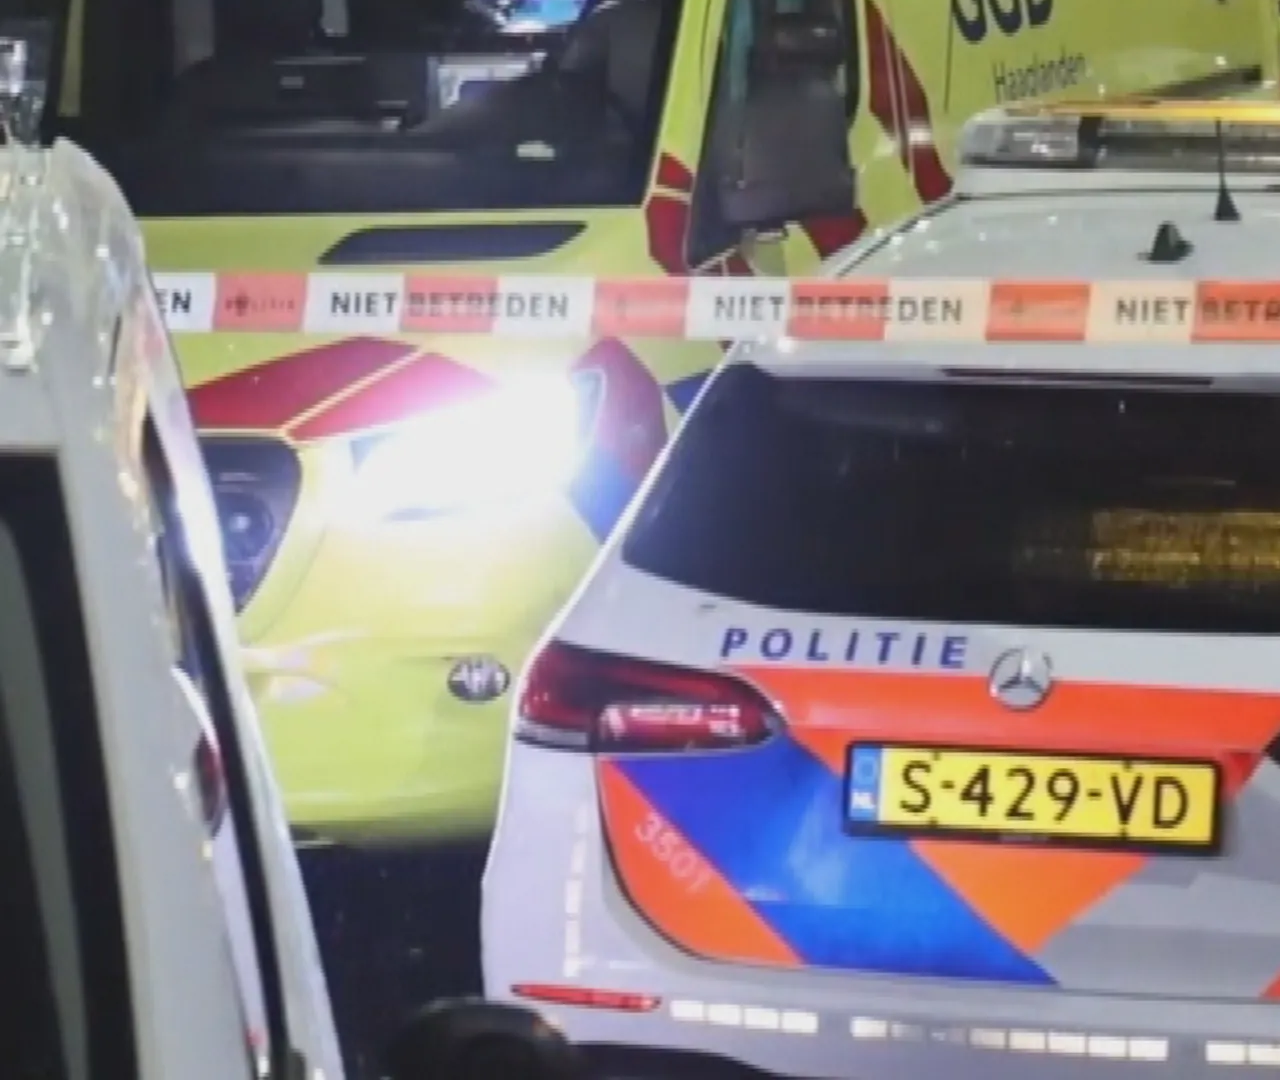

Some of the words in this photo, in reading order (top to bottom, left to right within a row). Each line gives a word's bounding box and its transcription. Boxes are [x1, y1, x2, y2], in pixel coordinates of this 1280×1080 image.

[331, 291, 397, 315] NIET
[408, 291, 569, 318] BETREDEN
[714, 295, 784, 322] NIET
[792, 295, 963, 324] BETREDEN
[1115, 296, 1191, 325] NIET
[719, 628, 968, 668] POLITIE
[899, 759, 1189, 829] S-429-VD
[634, 811, 714, 897] 3501
